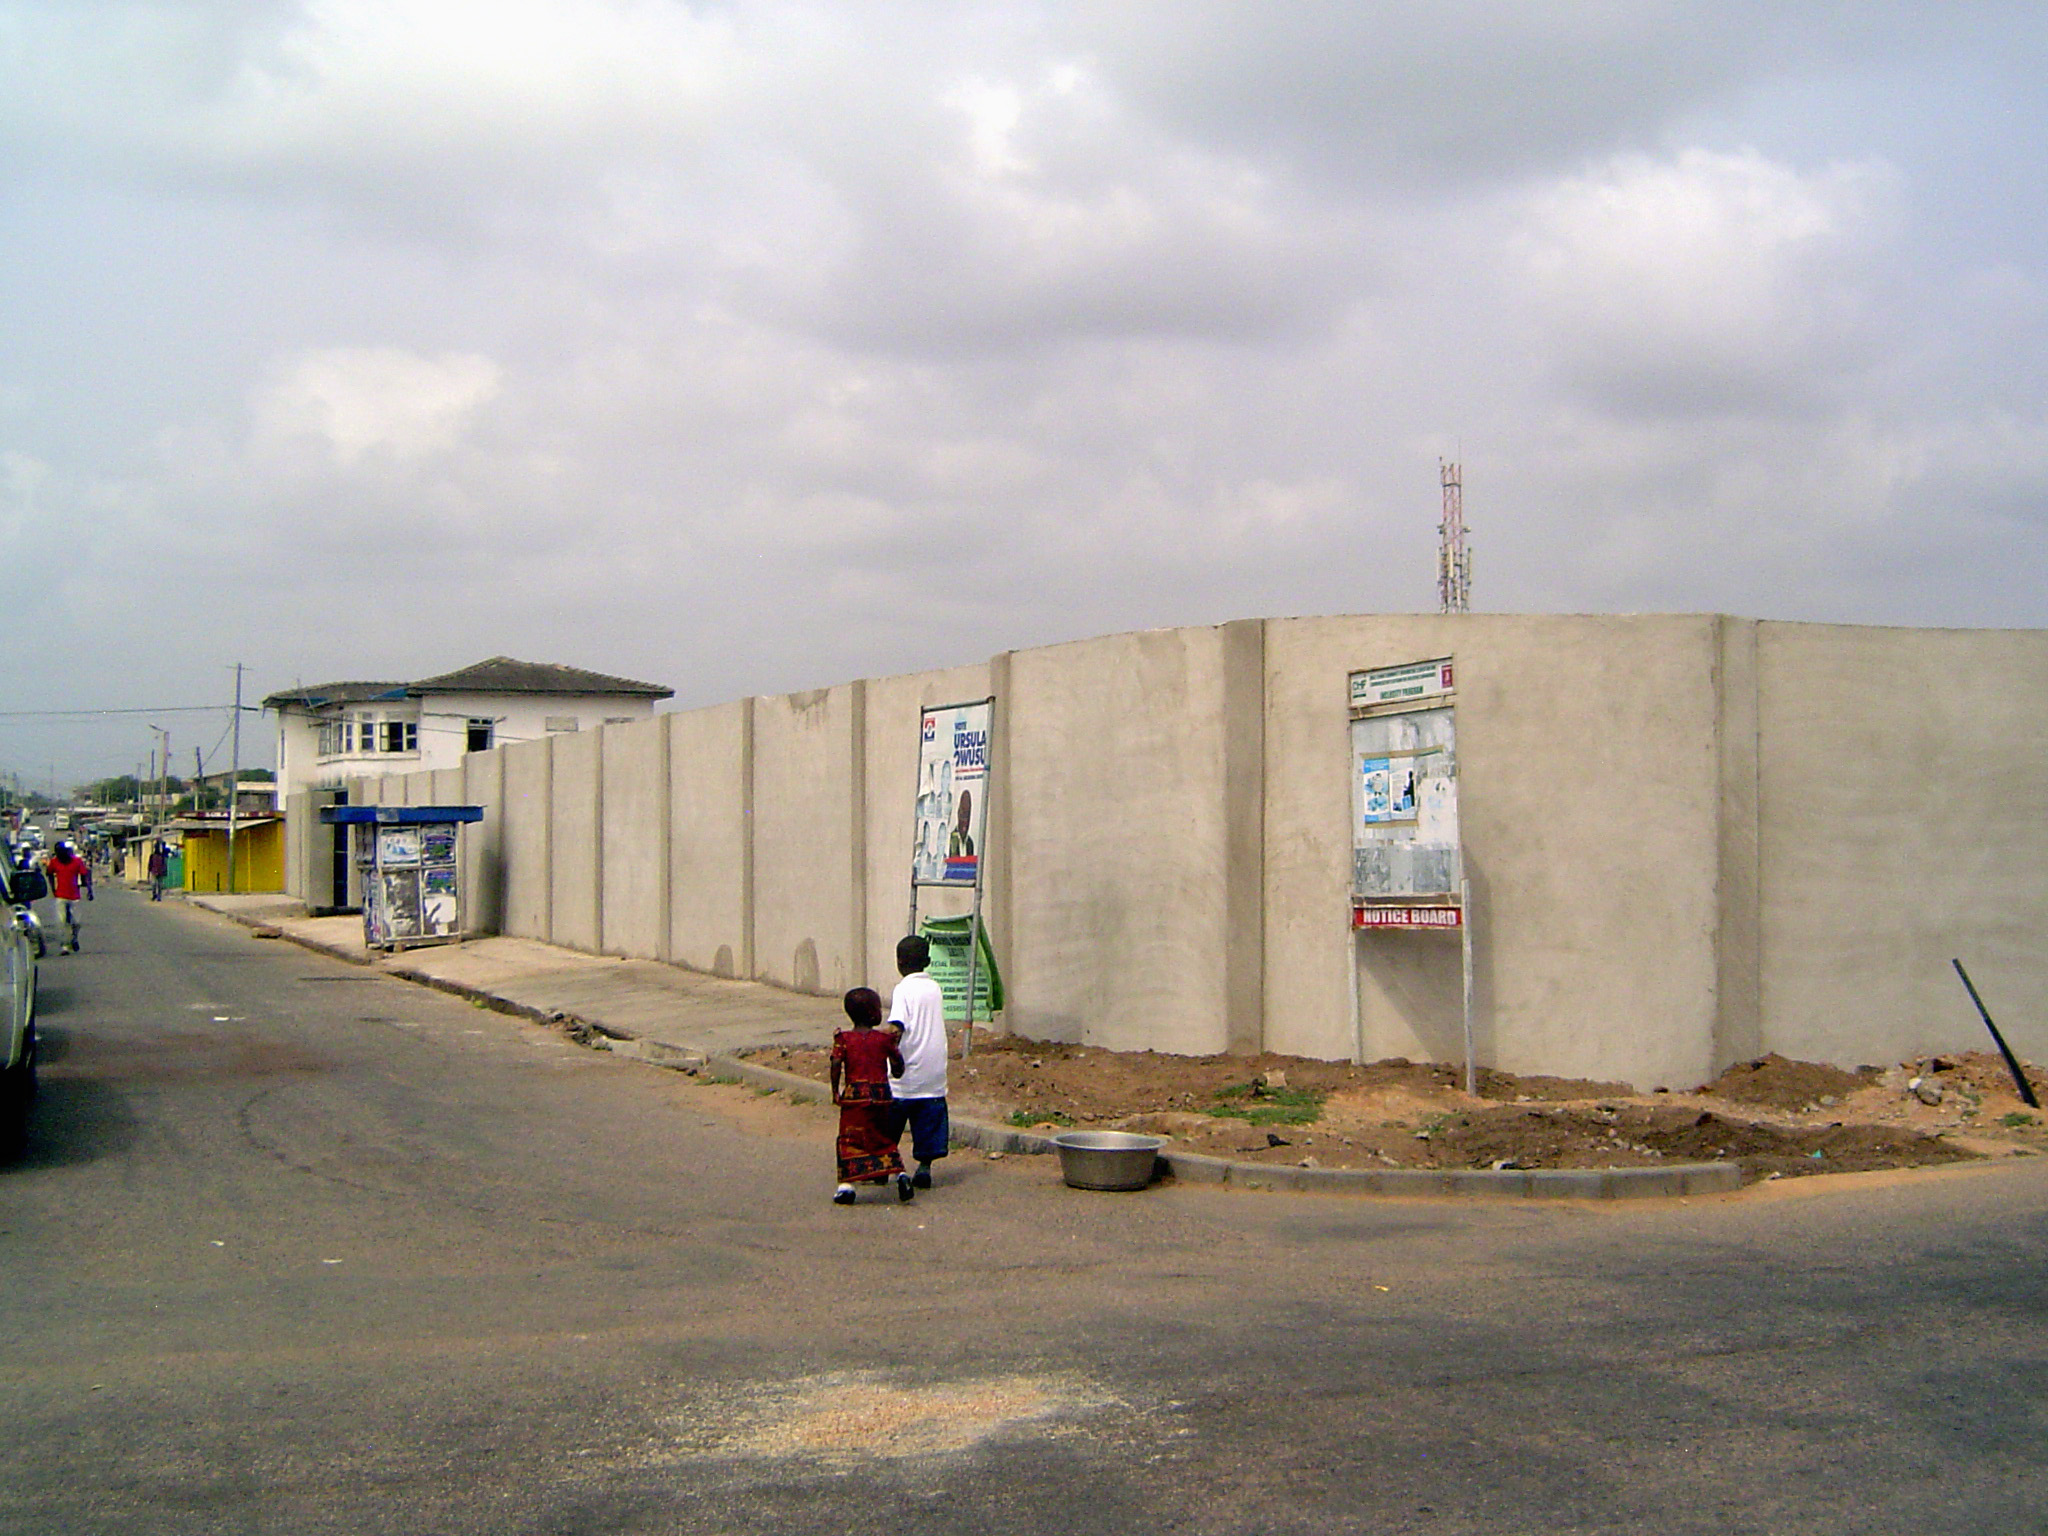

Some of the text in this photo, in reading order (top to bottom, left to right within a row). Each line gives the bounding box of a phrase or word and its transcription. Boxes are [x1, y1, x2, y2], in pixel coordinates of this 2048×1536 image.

[953, 730, 986, 749] URSULA
[1363, 909, 1457, 925] NOTICE BOARD
